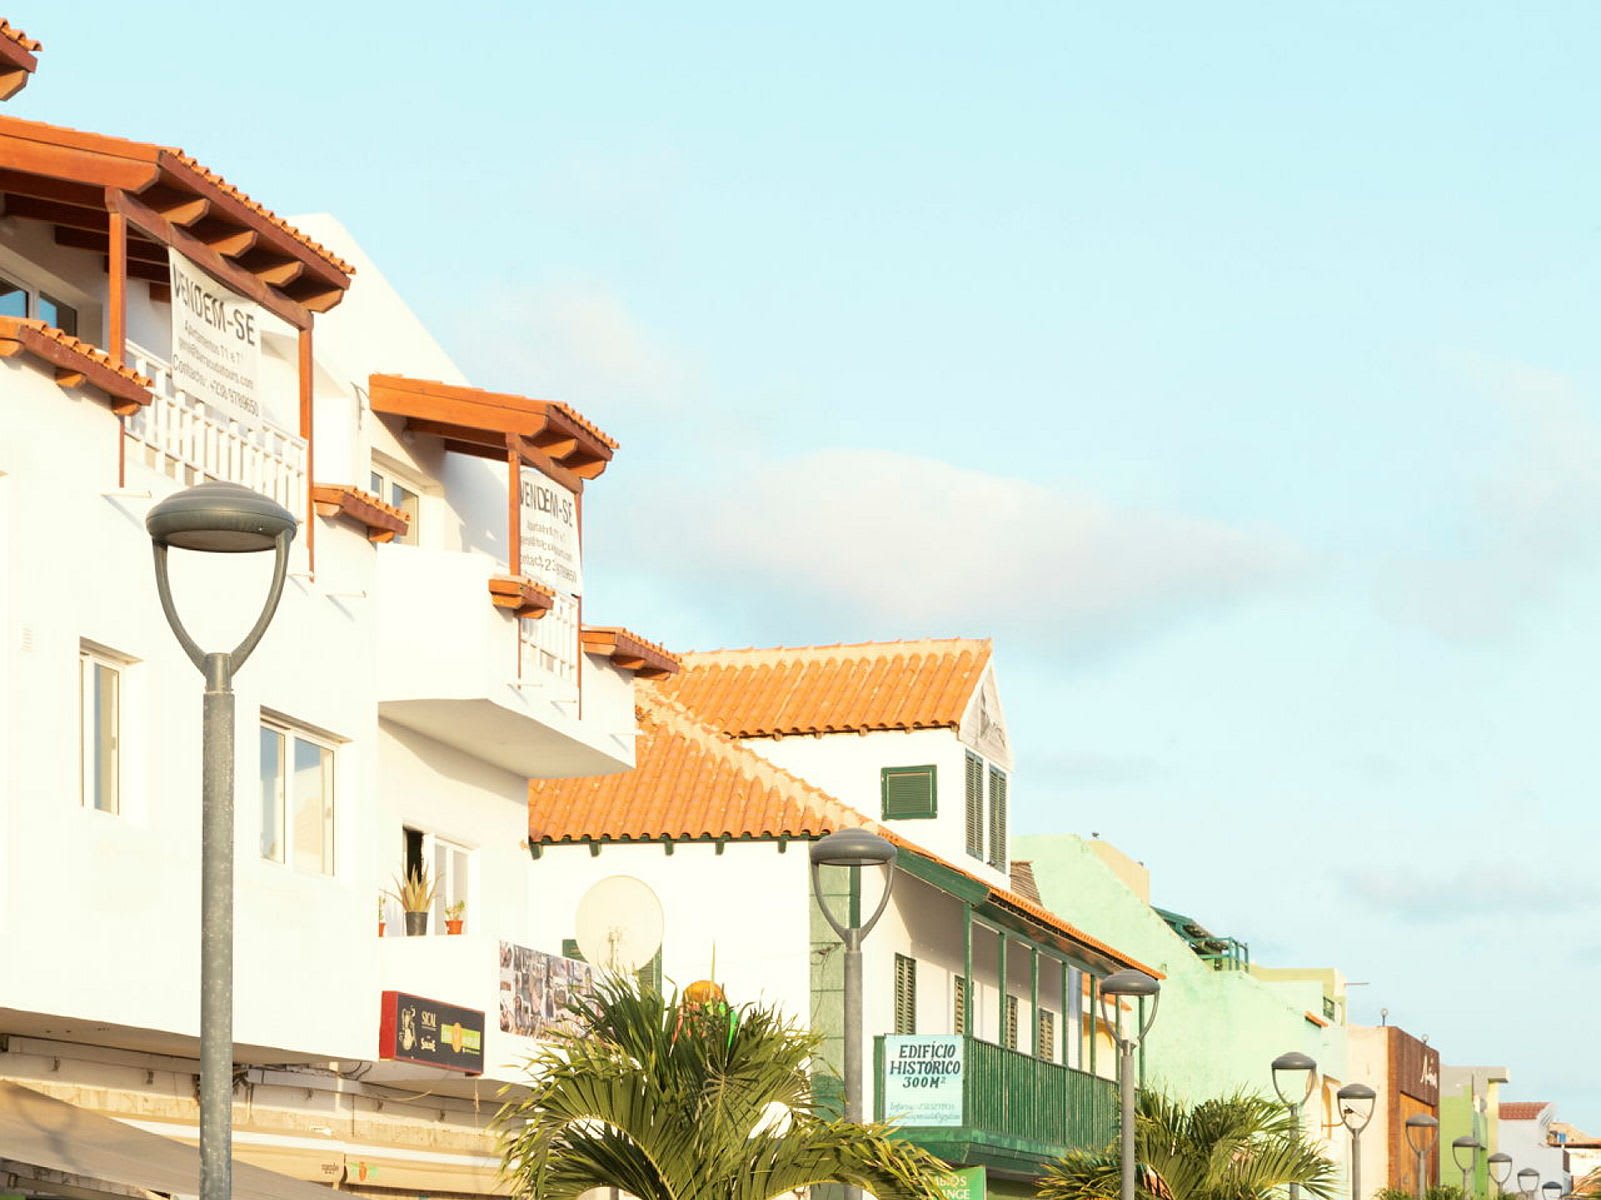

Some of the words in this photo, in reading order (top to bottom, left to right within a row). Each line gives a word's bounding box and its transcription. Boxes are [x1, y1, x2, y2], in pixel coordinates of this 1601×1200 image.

[173, 264, 255, 346] VENDEM-SE
[520, 480, 573, 527] VENDEM-SE
[899, 1041, 956, 1058] EDIFÍCIO
